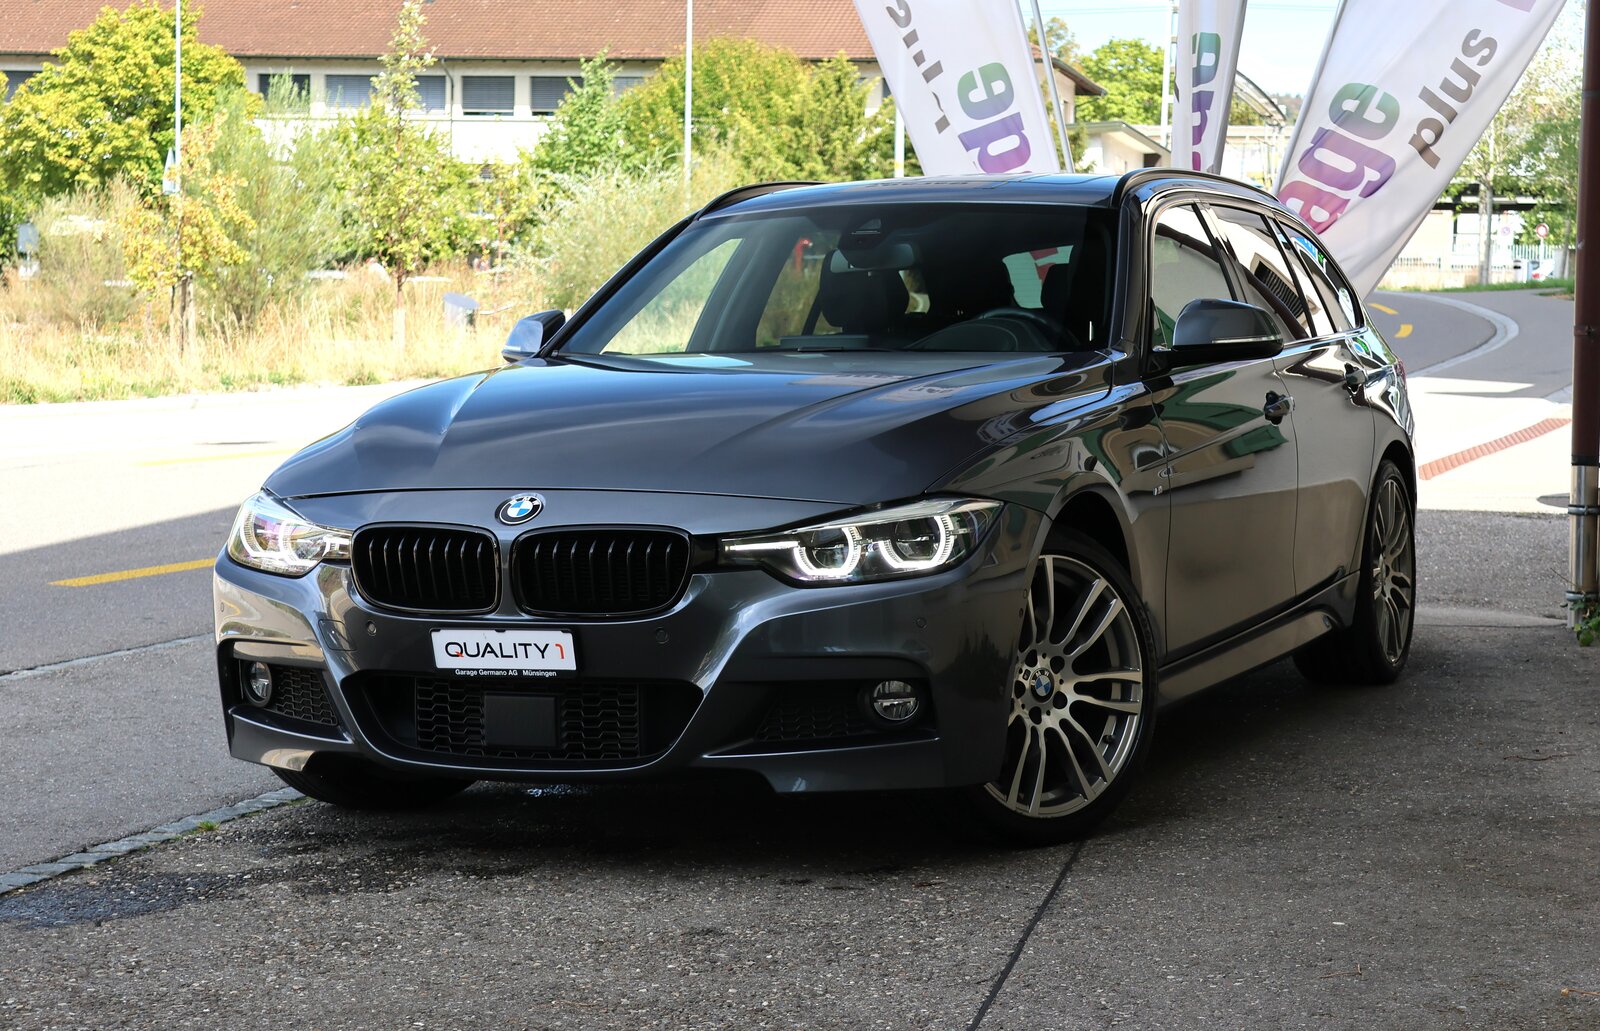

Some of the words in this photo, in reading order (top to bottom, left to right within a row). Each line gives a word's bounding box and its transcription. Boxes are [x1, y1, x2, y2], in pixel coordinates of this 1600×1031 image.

[1408, 28, 1498, 169] plus
[445, 642, 549, 659] QUALITY
[555, 643, 565, 659] 1
[455, 668, 478, 676] Garage
[522, 669, 557, 677] Münsingen
